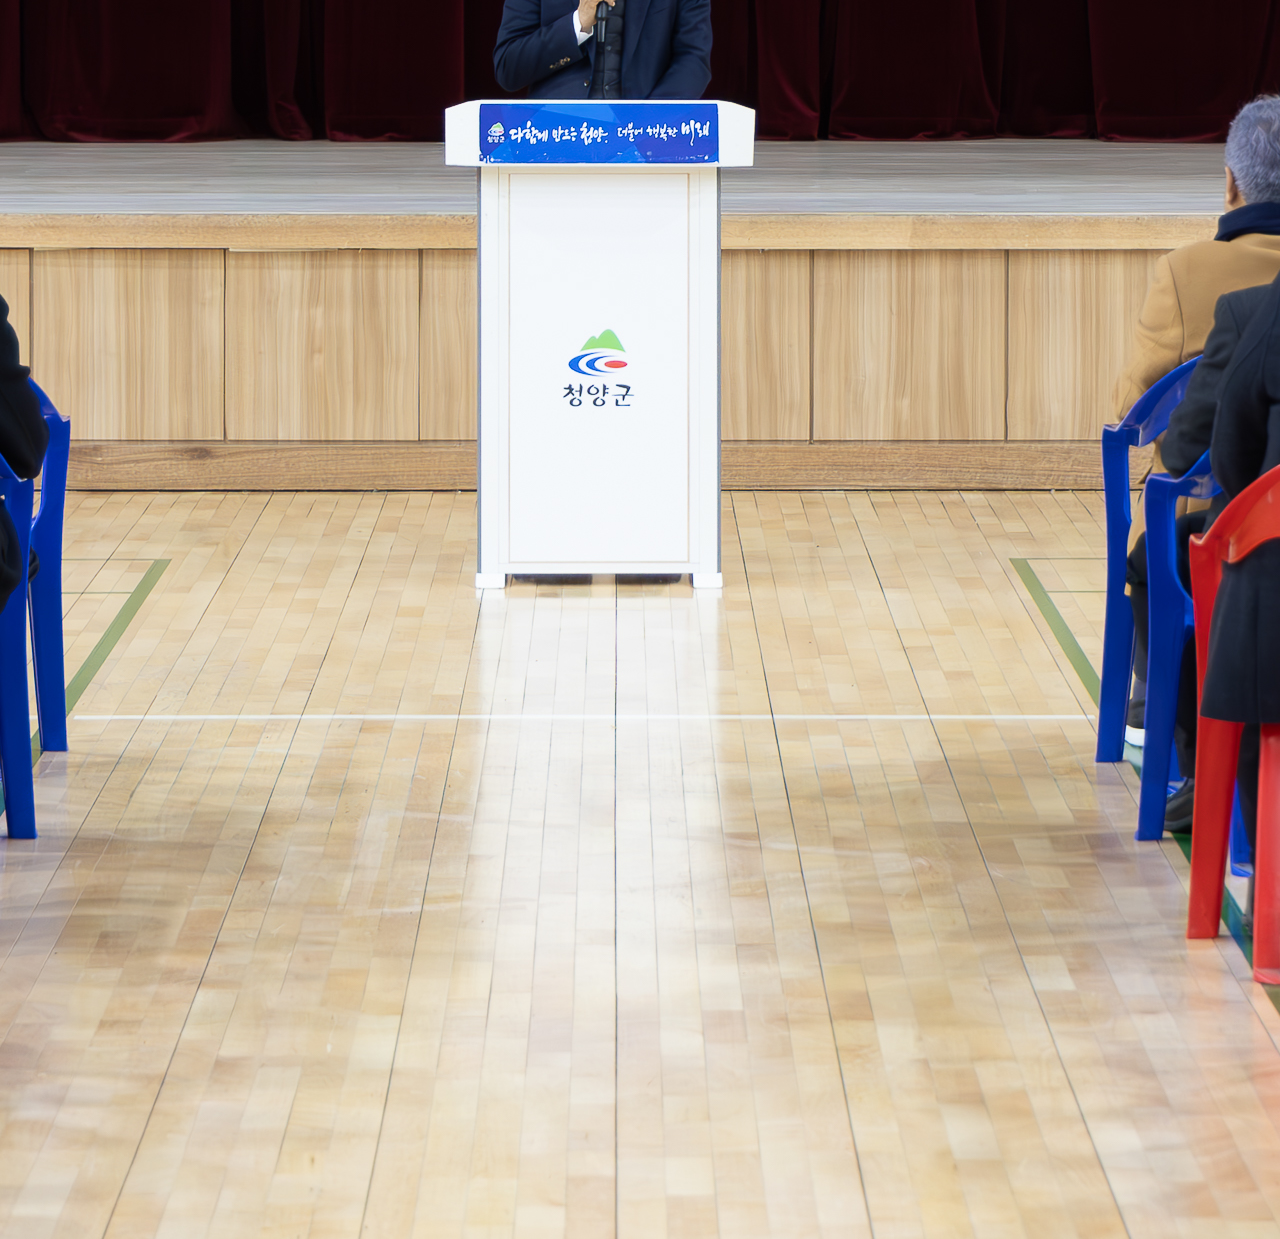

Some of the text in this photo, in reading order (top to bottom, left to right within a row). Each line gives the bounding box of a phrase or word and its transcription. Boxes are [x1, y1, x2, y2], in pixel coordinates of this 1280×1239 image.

[509, 120, 548, 144] 다함께
[552, 125, 577, 142] 만드는
[617, 122, 643, 142] 더불어
[646, 123, 678, 141] 행복한
[681, 119, 710, 146] 미래
[562, 383, 635, 407] 청양군
